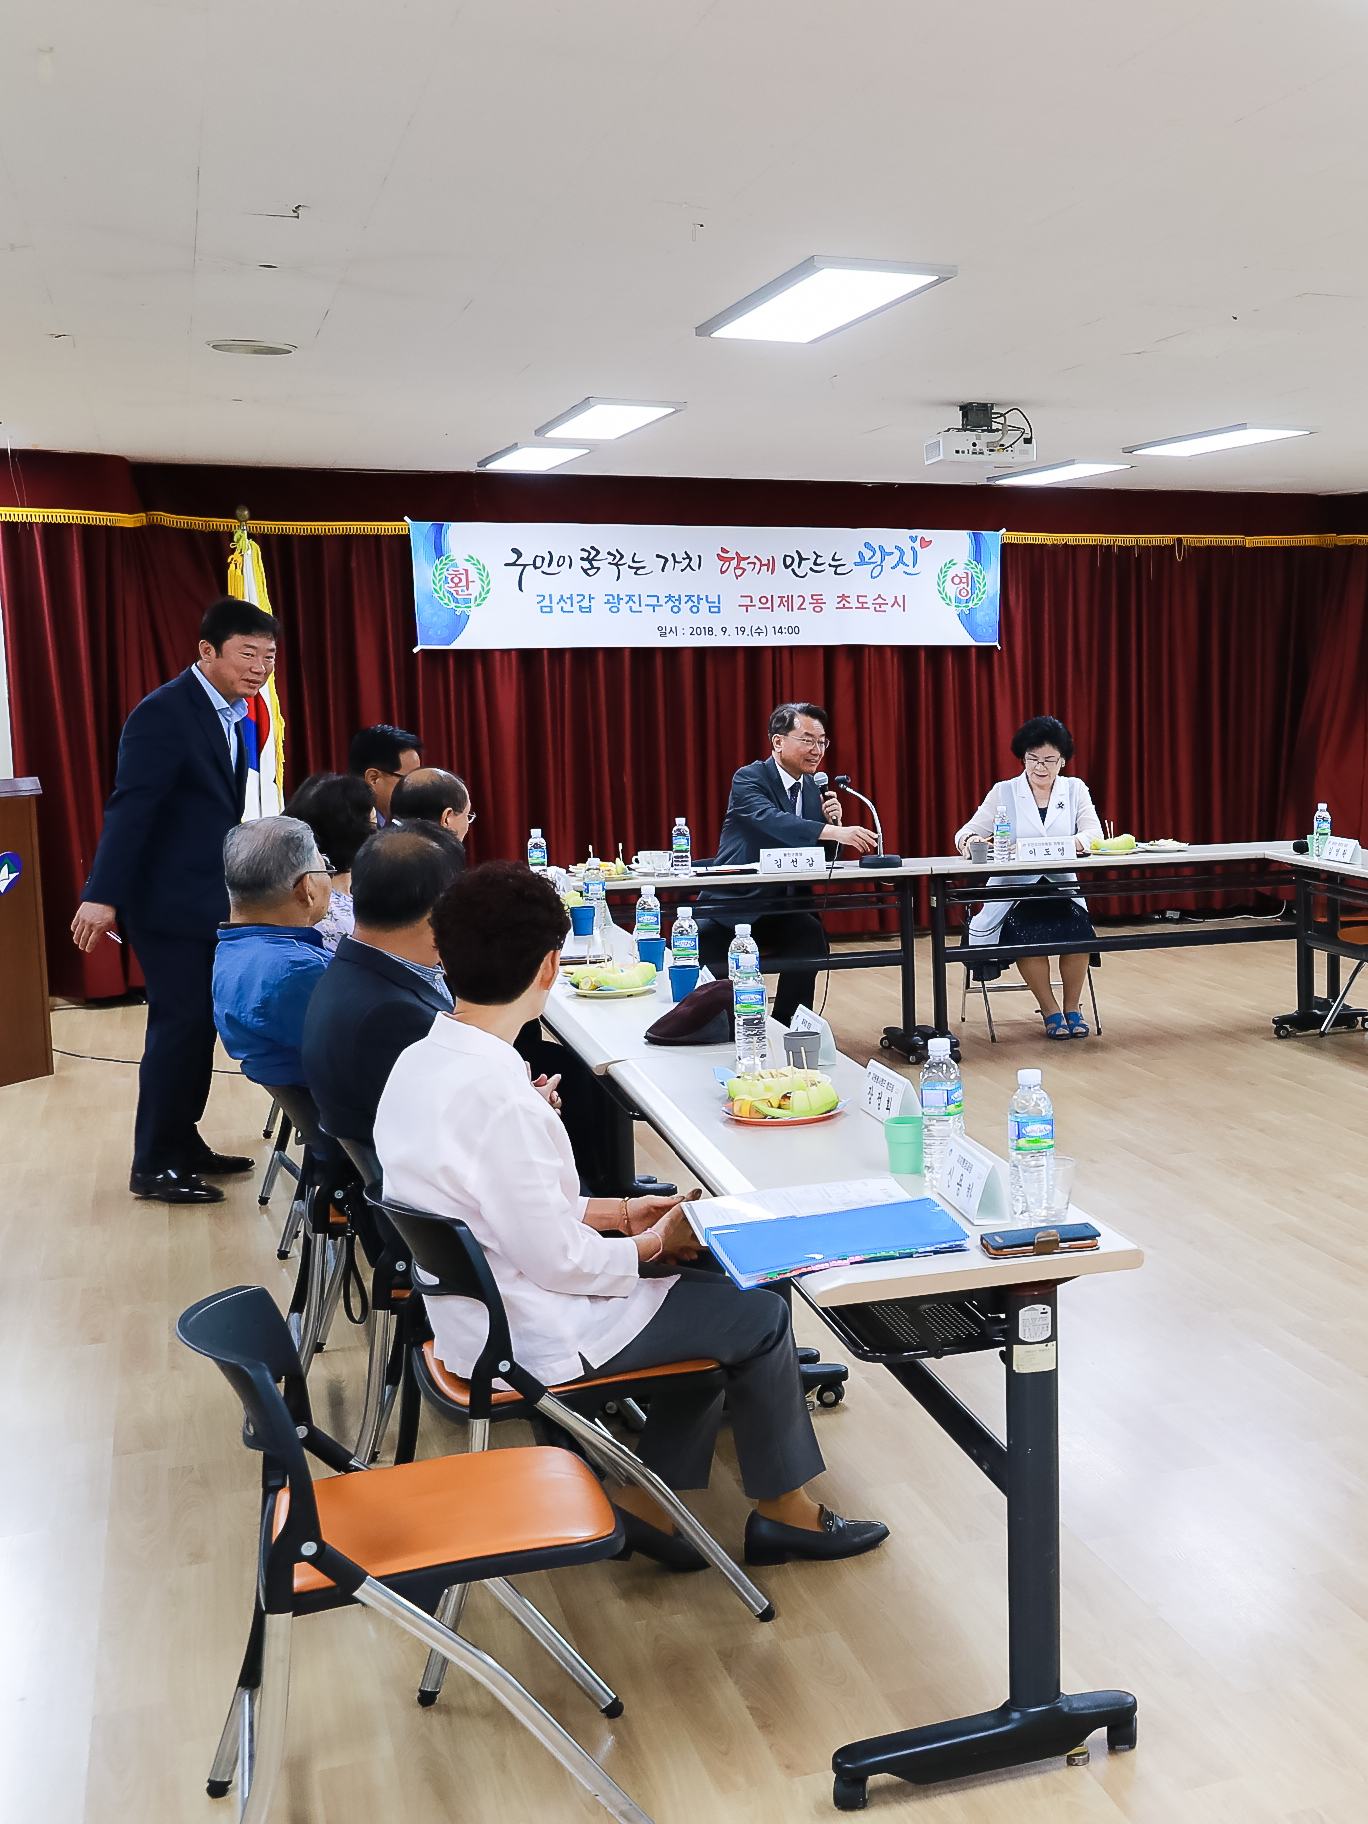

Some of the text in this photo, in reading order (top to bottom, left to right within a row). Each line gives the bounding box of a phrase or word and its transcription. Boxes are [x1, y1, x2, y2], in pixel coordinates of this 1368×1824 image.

[504, 537, 922, 592] 구민이 꿈꾸는 가치 함께 만드는 광진
[446, 568, 475, 596] 환
[951, 571, 970, 598] 영
[536, 594, 907, 614] 김선갑 광진구청장님 구의제2동 초도순시
[657, 626, 678, 638] 일시
[689, 626, 718, 636] 2018.
[721, 626, 731, 636] 9.
[772, 625, 800, 636] 14:00
[1028, 846, 1064, 857] 이도영
[774, 857, 814, 868] 김선갑
